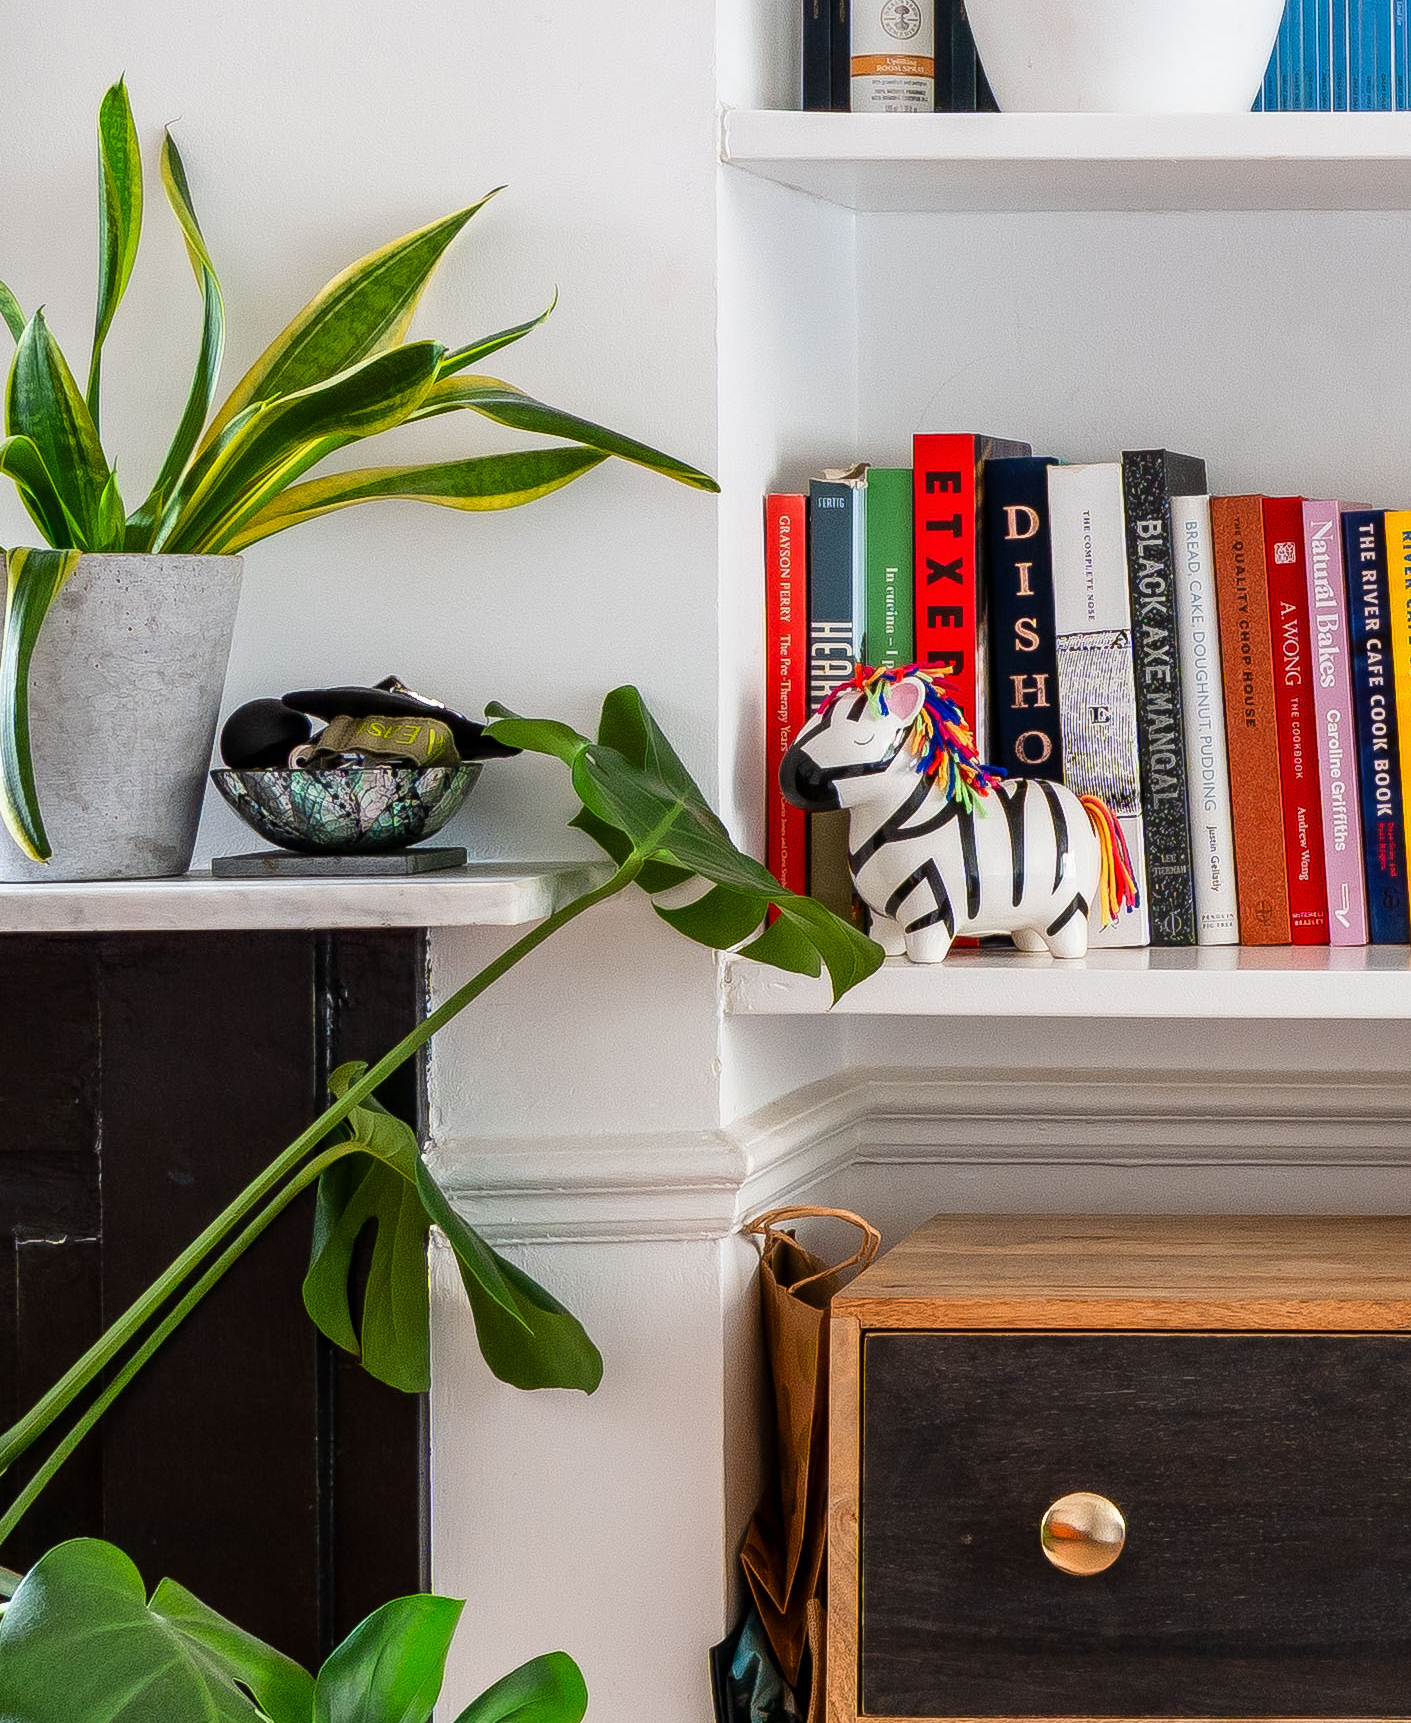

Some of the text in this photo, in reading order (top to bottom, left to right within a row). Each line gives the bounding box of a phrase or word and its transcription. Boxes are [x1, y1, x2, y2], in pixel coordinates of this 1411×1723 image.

[779, 515, 791, 622] GRAYSON PERRY
[1135, 520, 1179, 811] BLACK AXE MANGAL
[1310, 520, 1340, 688] Natural Bakes
[1359, 523, 1392, 816] THE RIVER CAFE COOK BOOK
